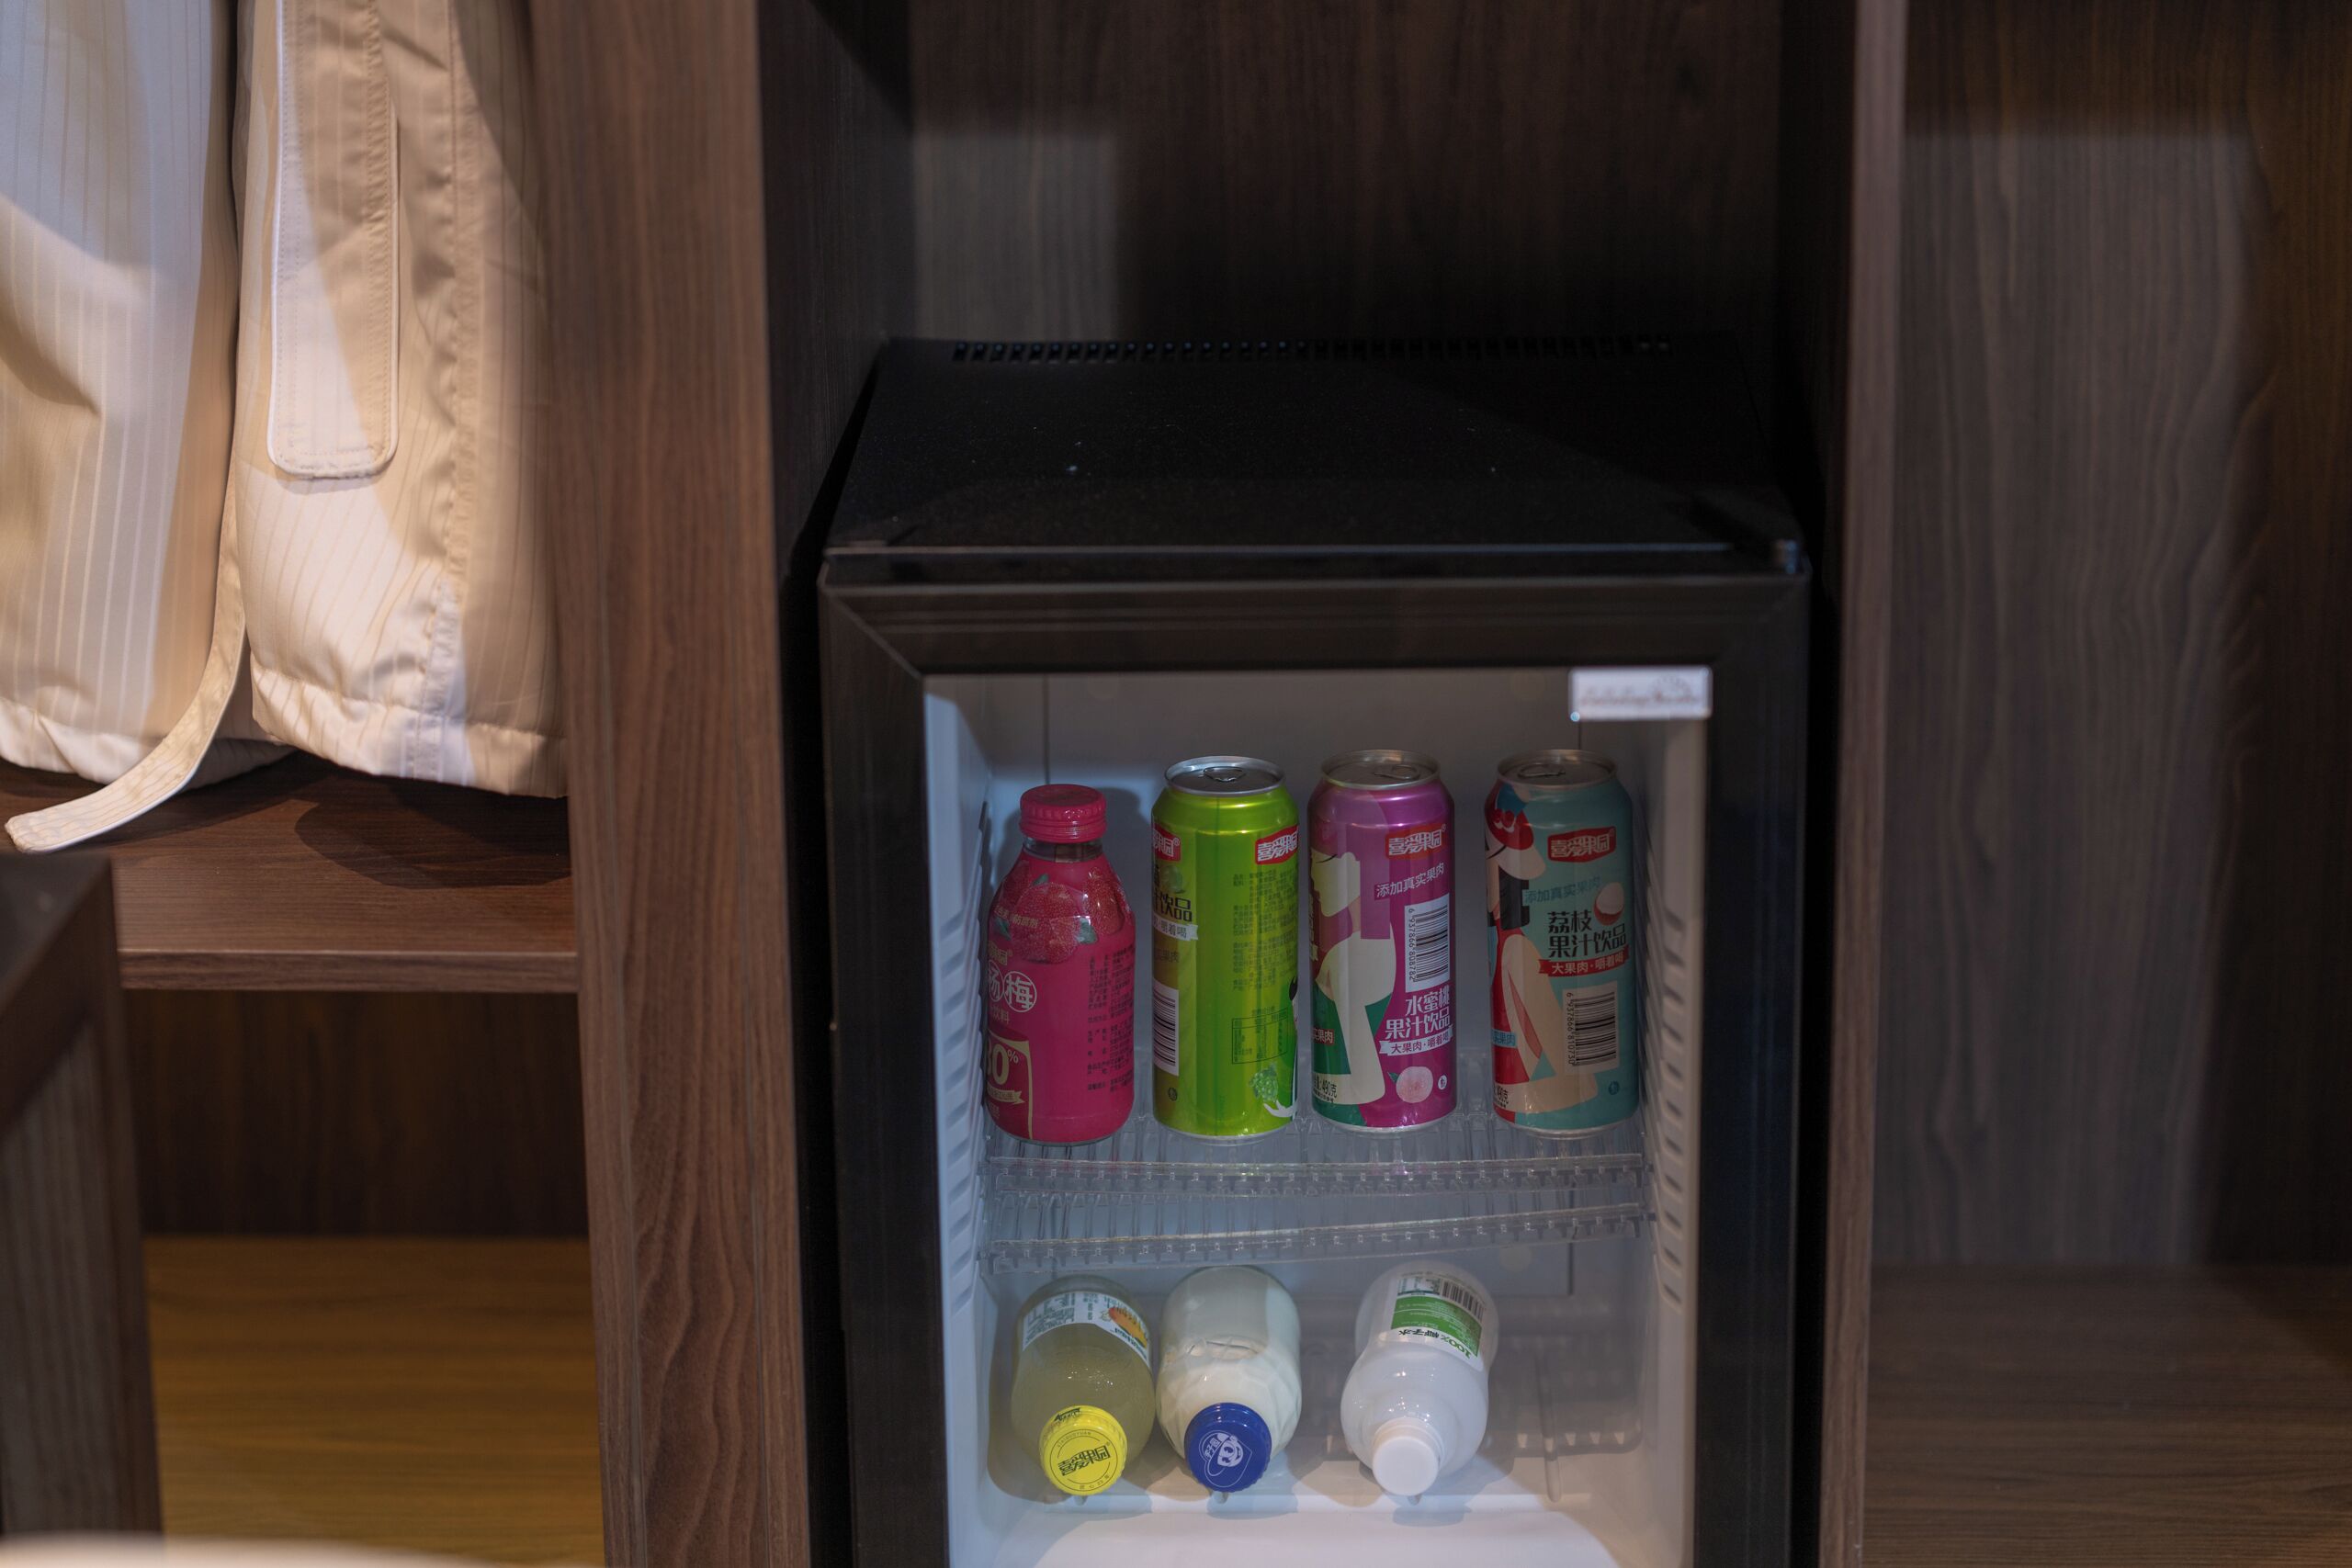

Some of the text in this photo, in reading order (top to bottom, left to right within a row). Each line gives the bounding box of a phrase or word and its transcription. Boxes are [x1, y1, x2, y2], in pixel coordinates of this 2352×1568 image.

[1388, 828, 1442, 856] 喜爱果园
[1550, 833, 1610, 859] 喜爱果园
[1376, 862, 1444, 898] 添加真实果肉
[1524, 876, 1602, 904] 添加真实果肉
[1547, 909, 1593, 934] 荔枝
[1548, 922, 1627, 958] 果汁饮品
[1405, 985, 1450, 1017] 水蜜桃
[1385, 1006, 1451, 1040] 果汁饮品
[1057, 1445, 1111, 1477] 喜爱果园
